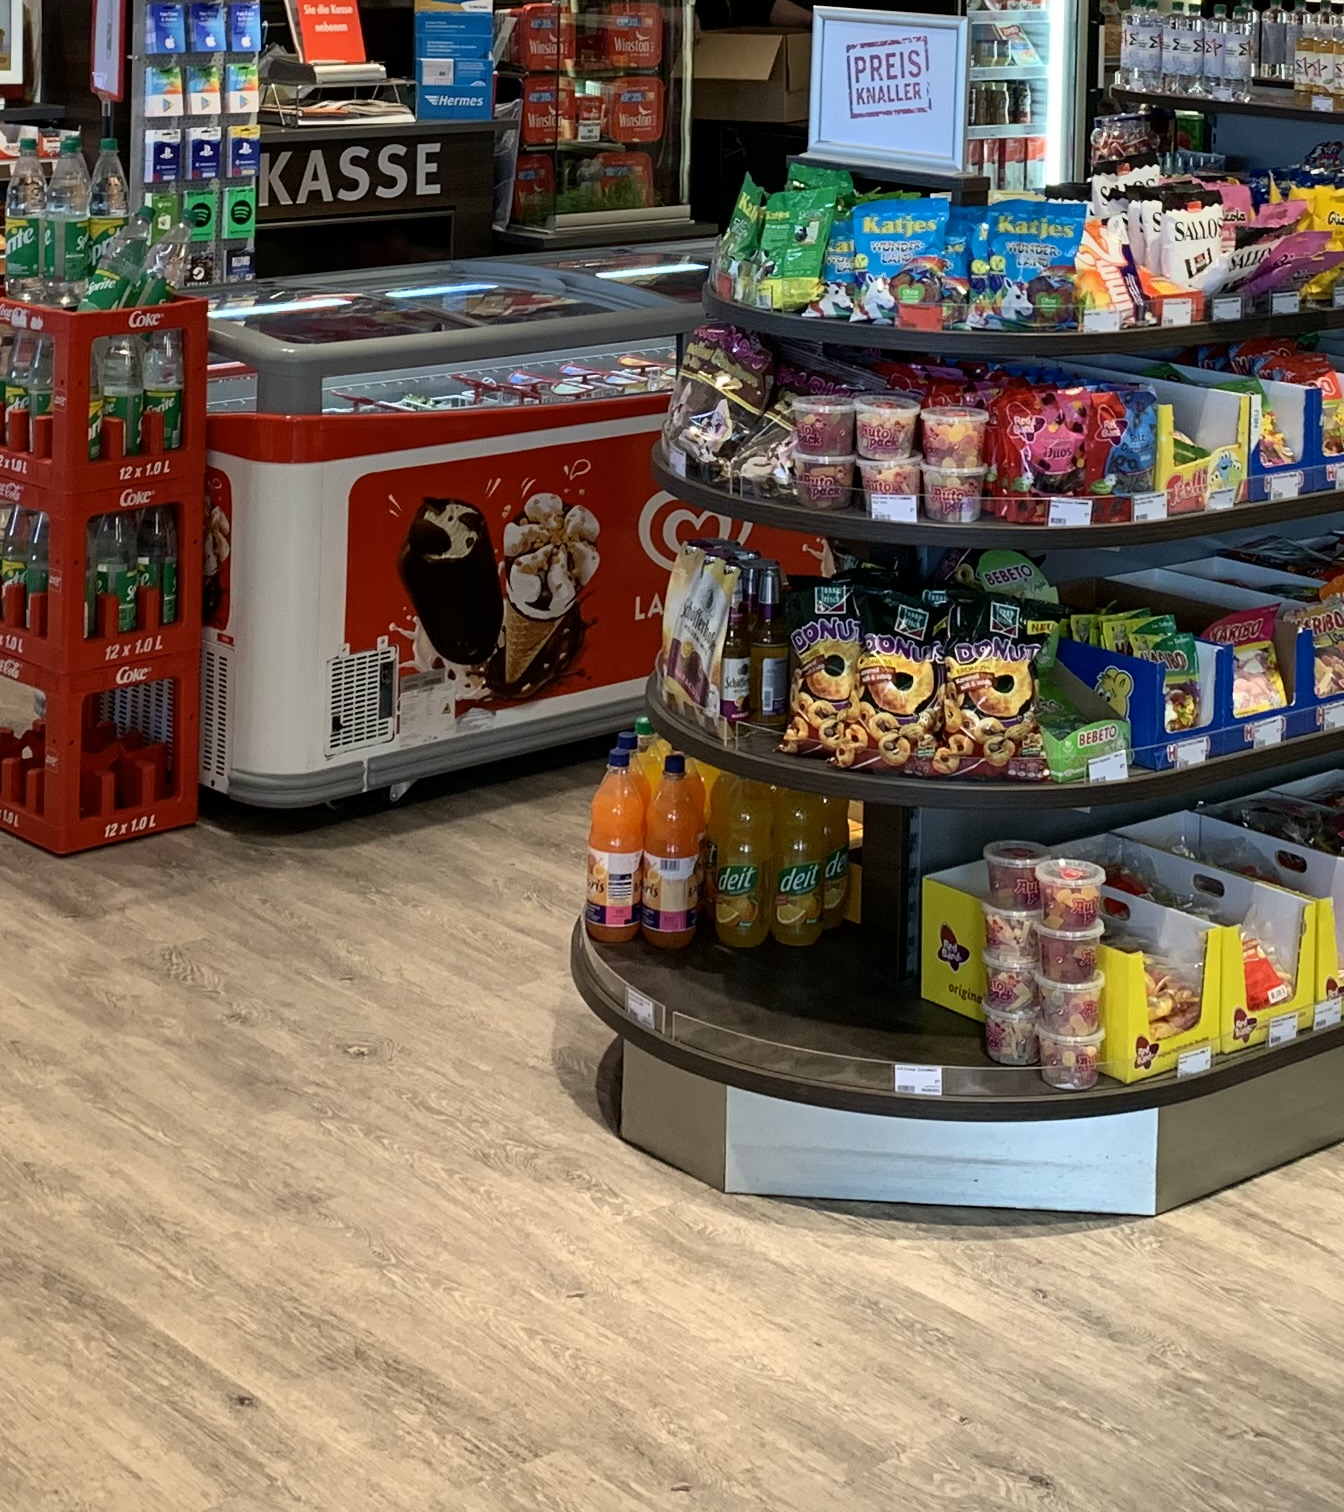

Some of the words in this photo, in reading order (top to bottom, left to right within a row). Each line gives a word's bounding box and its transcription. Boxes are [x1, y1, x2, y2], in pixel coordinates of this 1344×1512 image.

[855, 50, 922, 83] PREIS
[439, 95, 484, 107] Hermes
[856, 82, 922, 105] KNALLER
[258, 142, 442, 207] KASSE
[863, 215, 939, 237] Katjes
[997, 215, 1075, 239] Katjes
[129, 311, 161, 329] Coke
[119, 466, 131, 480] 12
[146, 462, 160, 476] 1.0
[119, 489, 152, 508] Coke
[984, 564, 1033, 586] BEBETO
[105, 645, 118, 661] 12
[135, 639, 152, 655] 1.0
[863, 633, 945, 665] DONUTS
[116, 666, 149, 685] Coke
[1078, 725, 1118, 747] BEBETO
[104, 823, 117, 838] 12
[131, 817, 146, 831] 1.0
[718, 866, 755, 891] deit
[780, 864, 821, 893] deit
